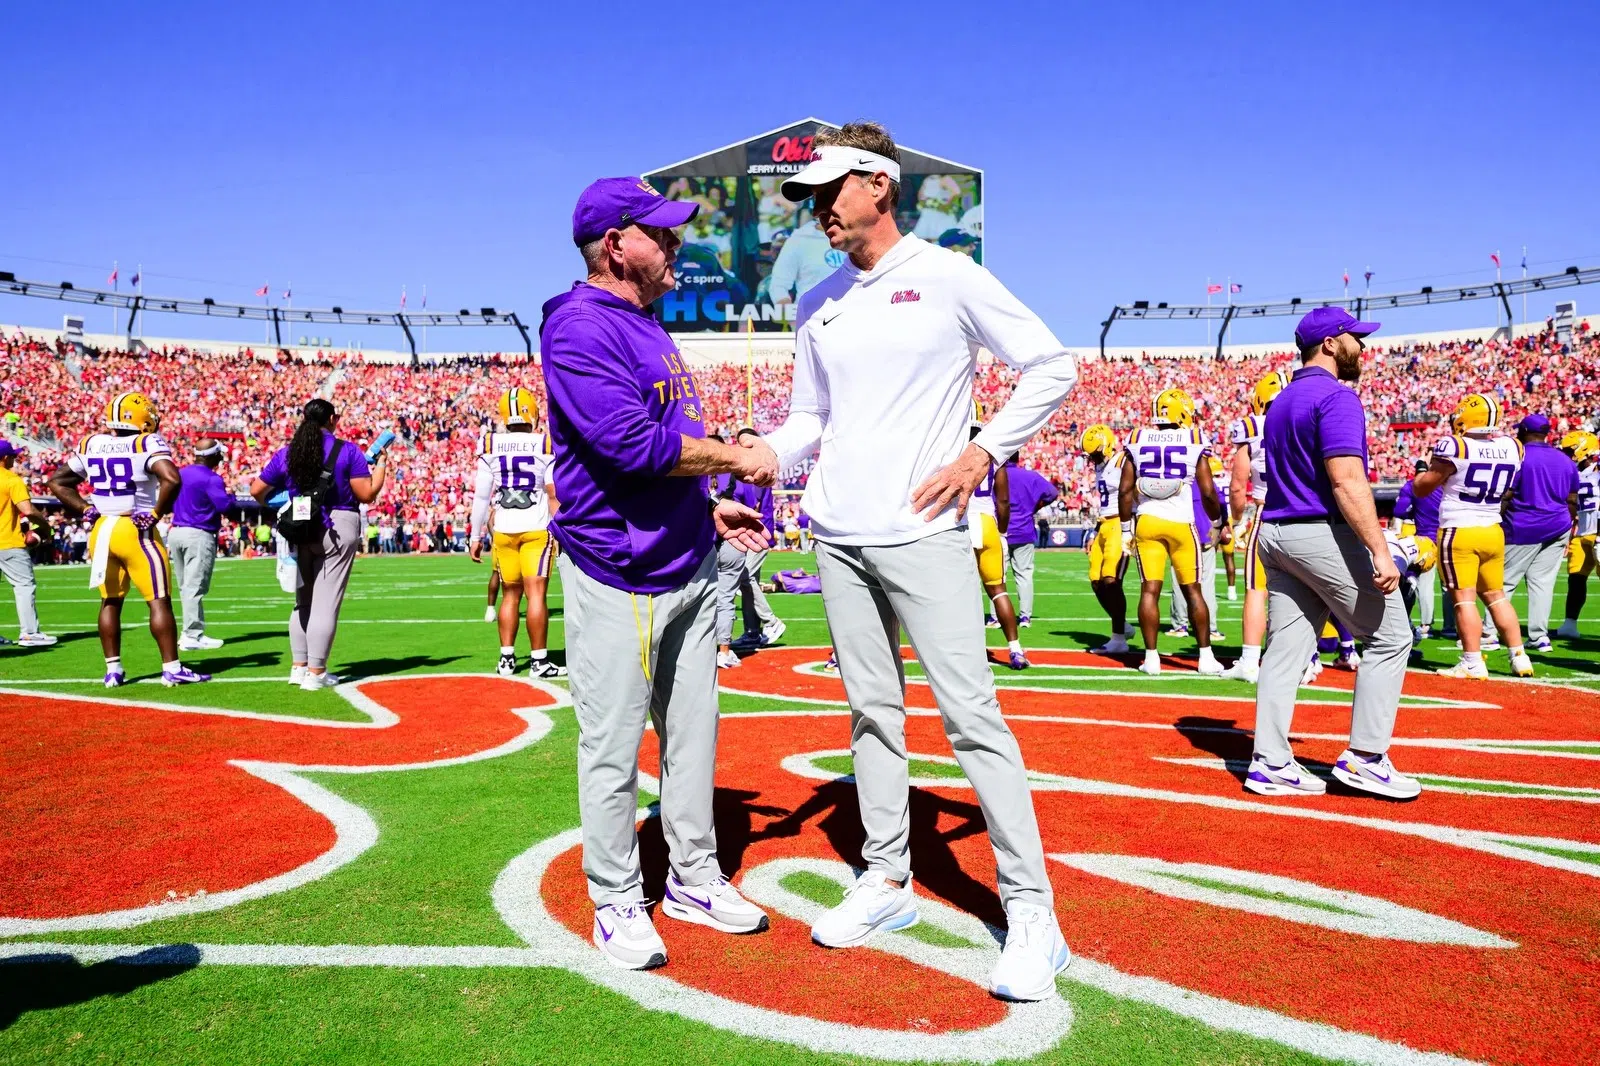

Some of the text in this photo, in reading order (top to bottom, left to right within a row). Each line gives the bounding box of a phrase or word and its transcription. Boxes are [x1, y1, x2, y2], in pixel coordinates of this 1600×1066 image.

[747, 164, 776, 174] JERRY
[693, 274, 724, 286] spire
[890, 289, 921, 304] Ole Miss
[724, 303, 797, 322] LANE
[1147, 433, 1182, 443] ROSS II
[96, 442, 130, 454] JACKSON
[497, 442, 539, 453] HURLEY
[1478, 448, 1509, 460] KELLY
[1139, 446, 1188, 479] 26
[87, 457, 137, 497] 28
[499, 455, 536, 491] 16
[1458, 462, 1516, 504] 50
